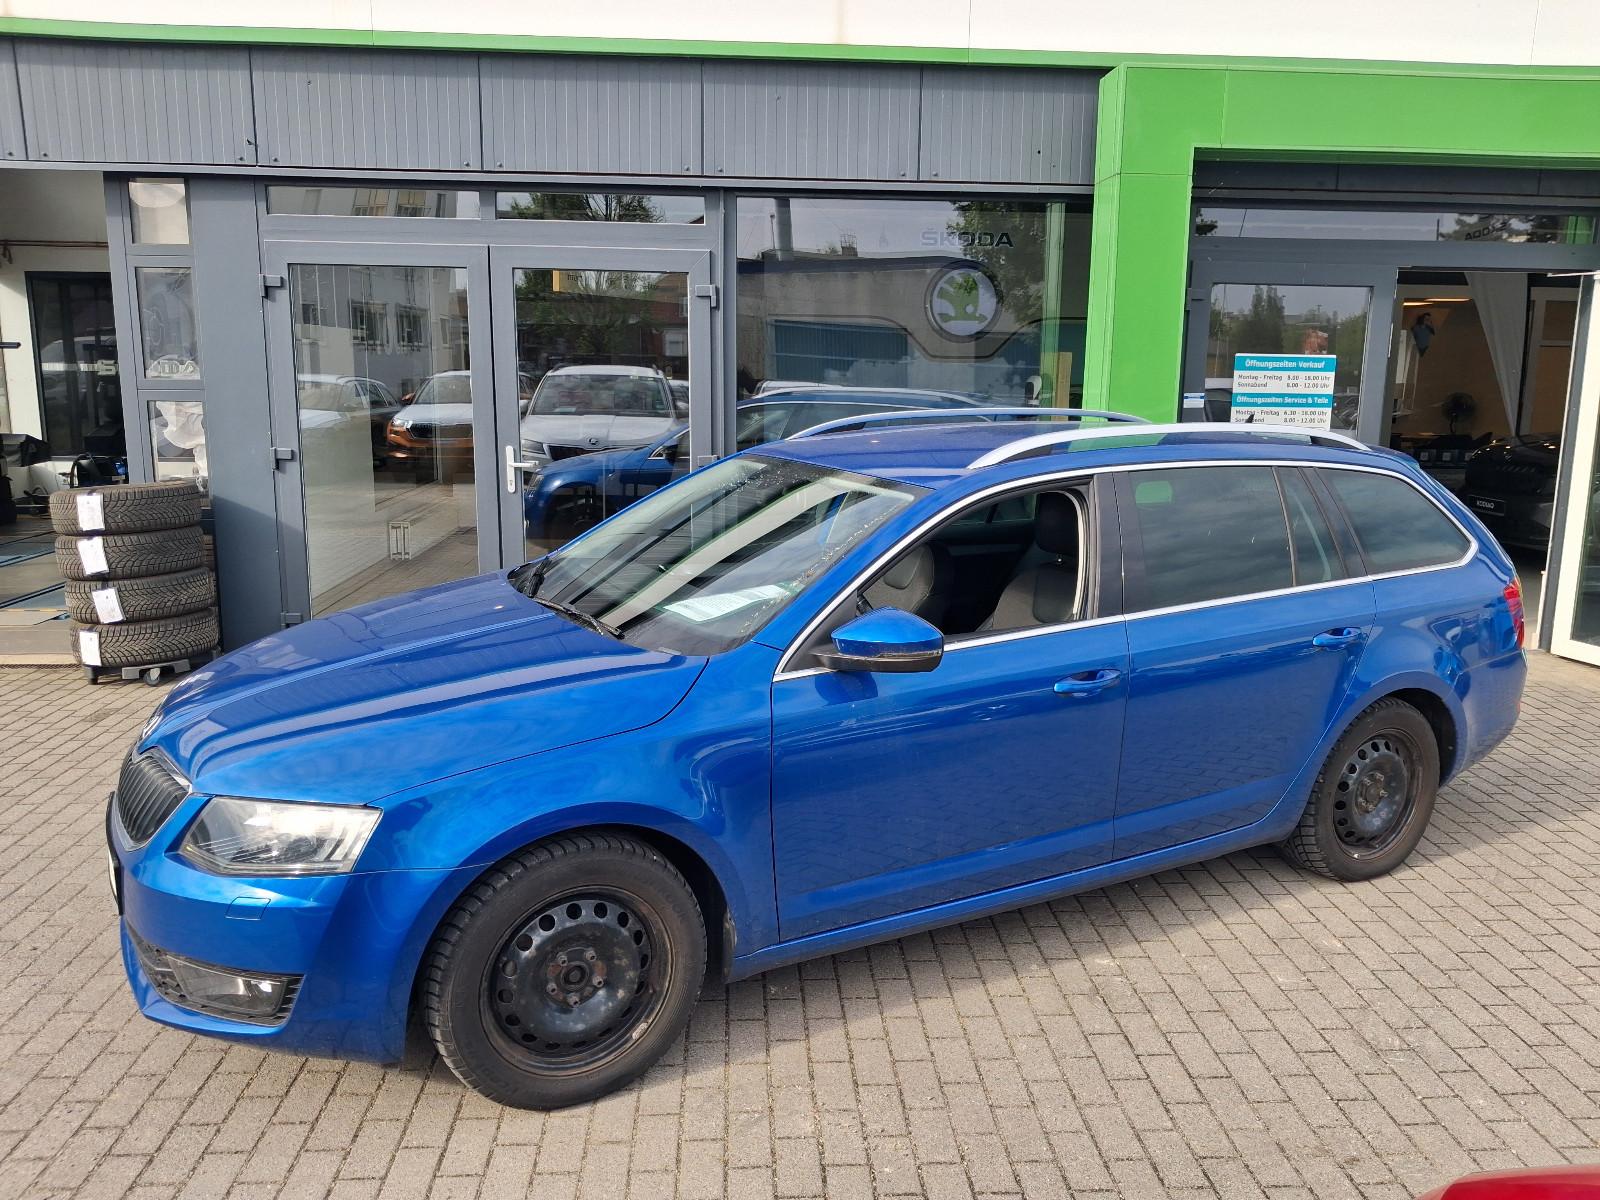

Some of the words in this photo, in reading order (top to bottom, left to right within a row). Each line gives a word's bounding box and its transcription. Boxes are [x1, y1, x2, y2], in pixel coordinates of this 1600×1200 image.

[920, 227, 1014, 248] ŠKODA
[1245, 358, 1296, 368] Öffnungszeiten
[1299, 360, 1325, 369] Verkauf
[1236, 395, 1283, 404] Öffnungszeiten
[1284, 396, 1307, 404] Service
